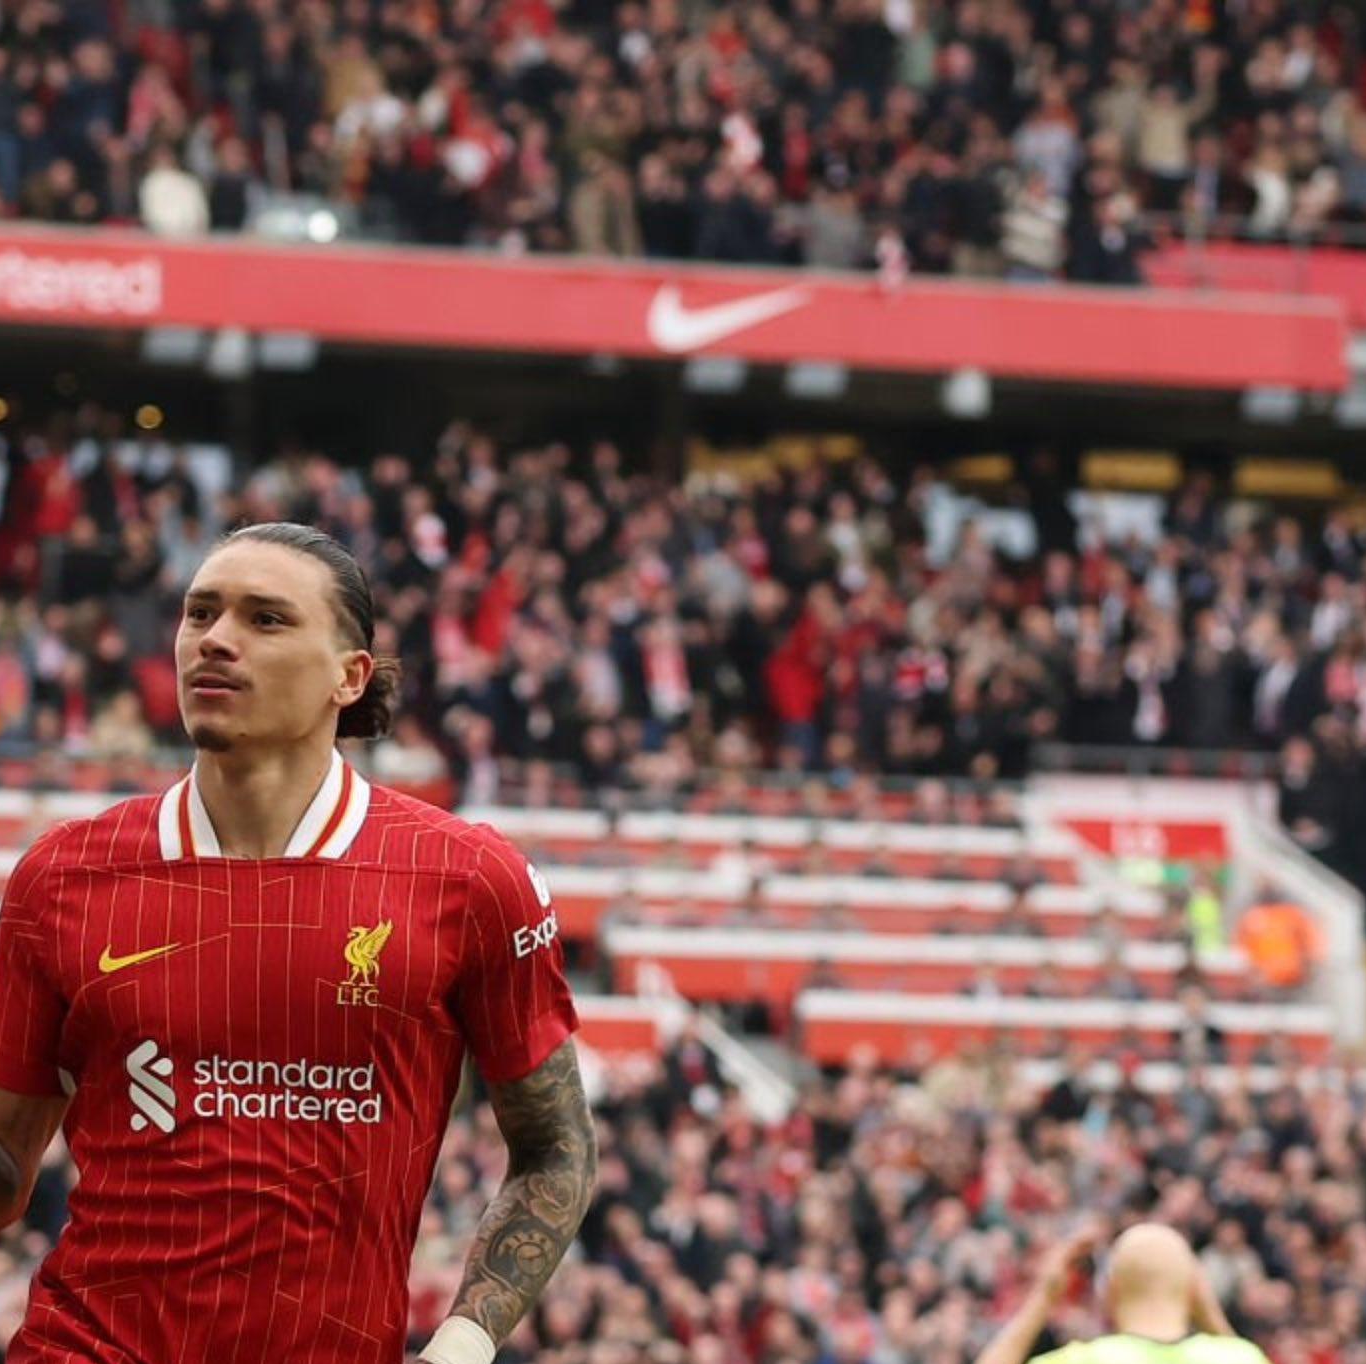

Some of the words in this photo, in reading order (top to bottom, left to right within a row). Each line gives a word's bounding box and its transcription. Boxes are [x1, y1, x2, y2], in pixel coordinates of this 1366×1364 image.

[513, 909, 557, 959] Exp
[336, 987, 379, 1006] LFC
[193, 1054, 374, 1091] standard
[193, 1086, 382, 1123] chartered
